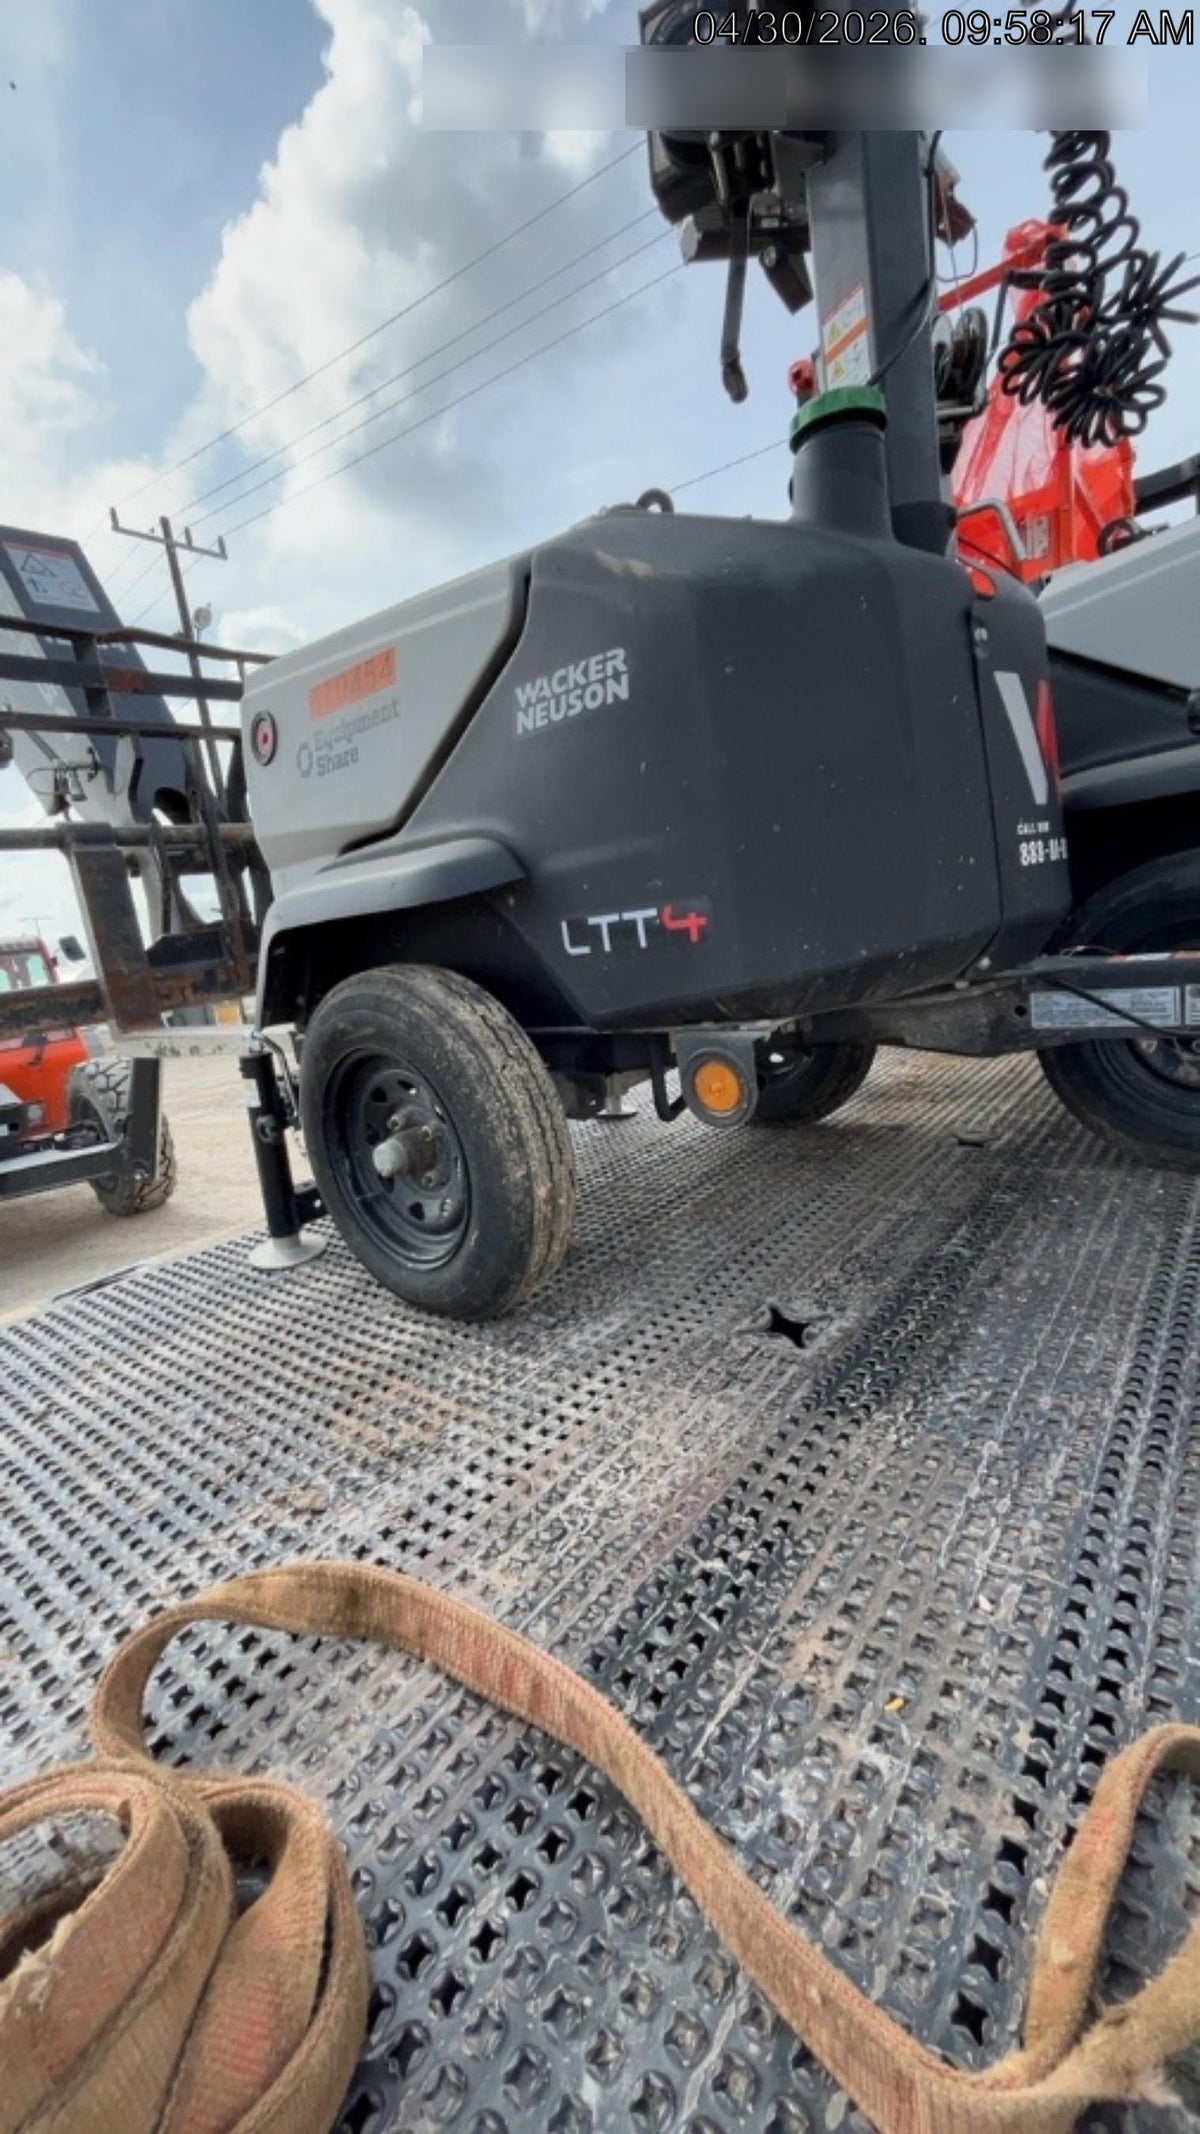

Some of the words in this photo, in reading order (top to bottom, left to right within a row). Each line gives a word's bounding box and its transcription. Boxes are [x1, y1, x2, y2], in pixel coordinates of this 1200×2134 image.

[515, 647, 627, 709] WACKER
[517, 673, 629, 735] NEUSON
[316, 746, 359, 777] Share
[561, 905, 707, 956] LTT4
